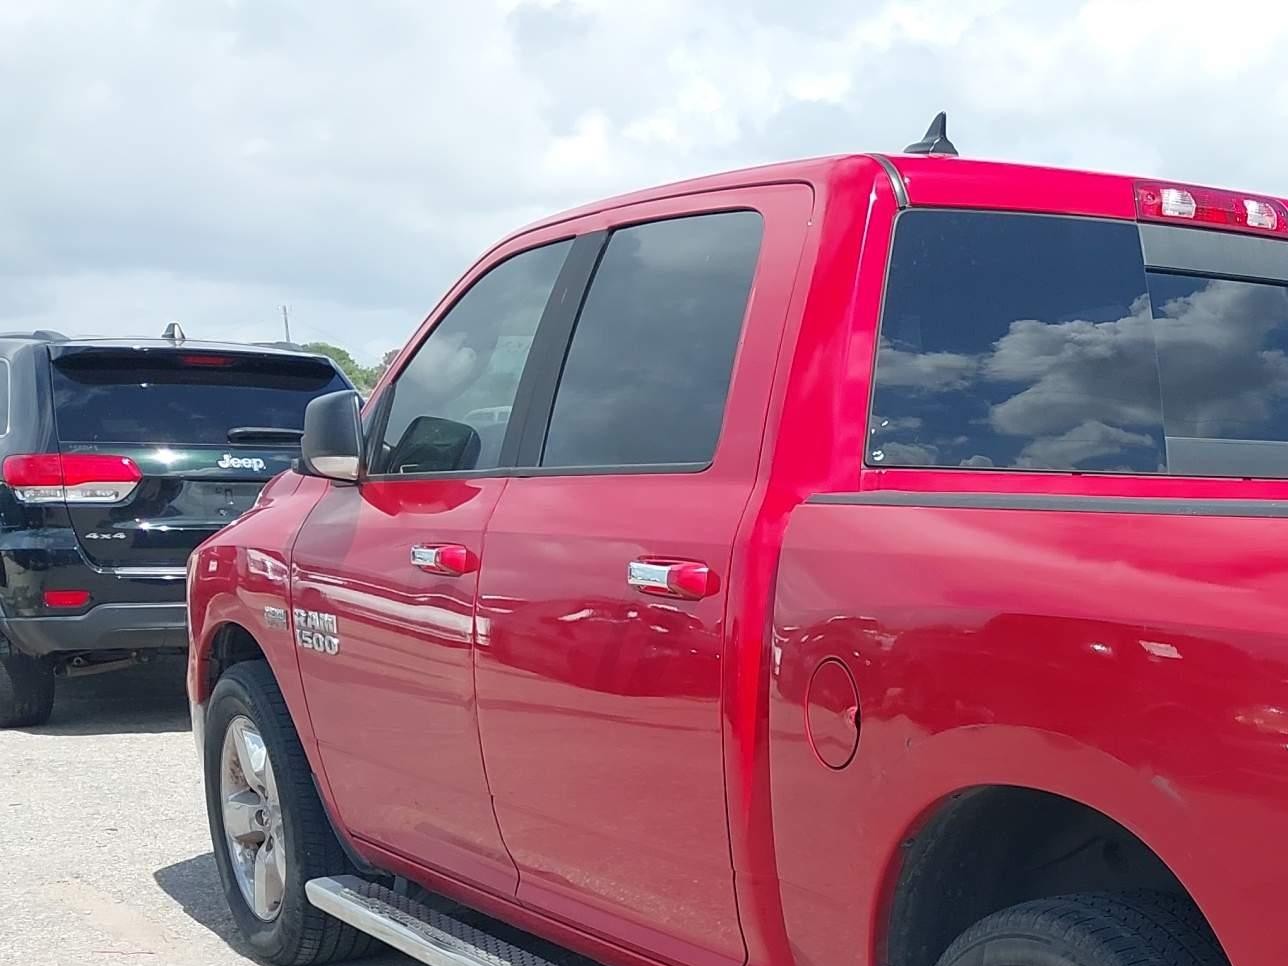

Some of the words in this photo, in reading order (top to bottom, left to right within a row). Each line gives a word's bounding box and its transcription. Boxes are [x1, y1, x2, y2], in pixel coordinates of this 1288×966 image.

[217, 453, 265, 471] Jeep
[85, 532, 127, 540] 4x4
[294, 608, 338, 634] RAM
[296, 628, 340, 656] 1500
